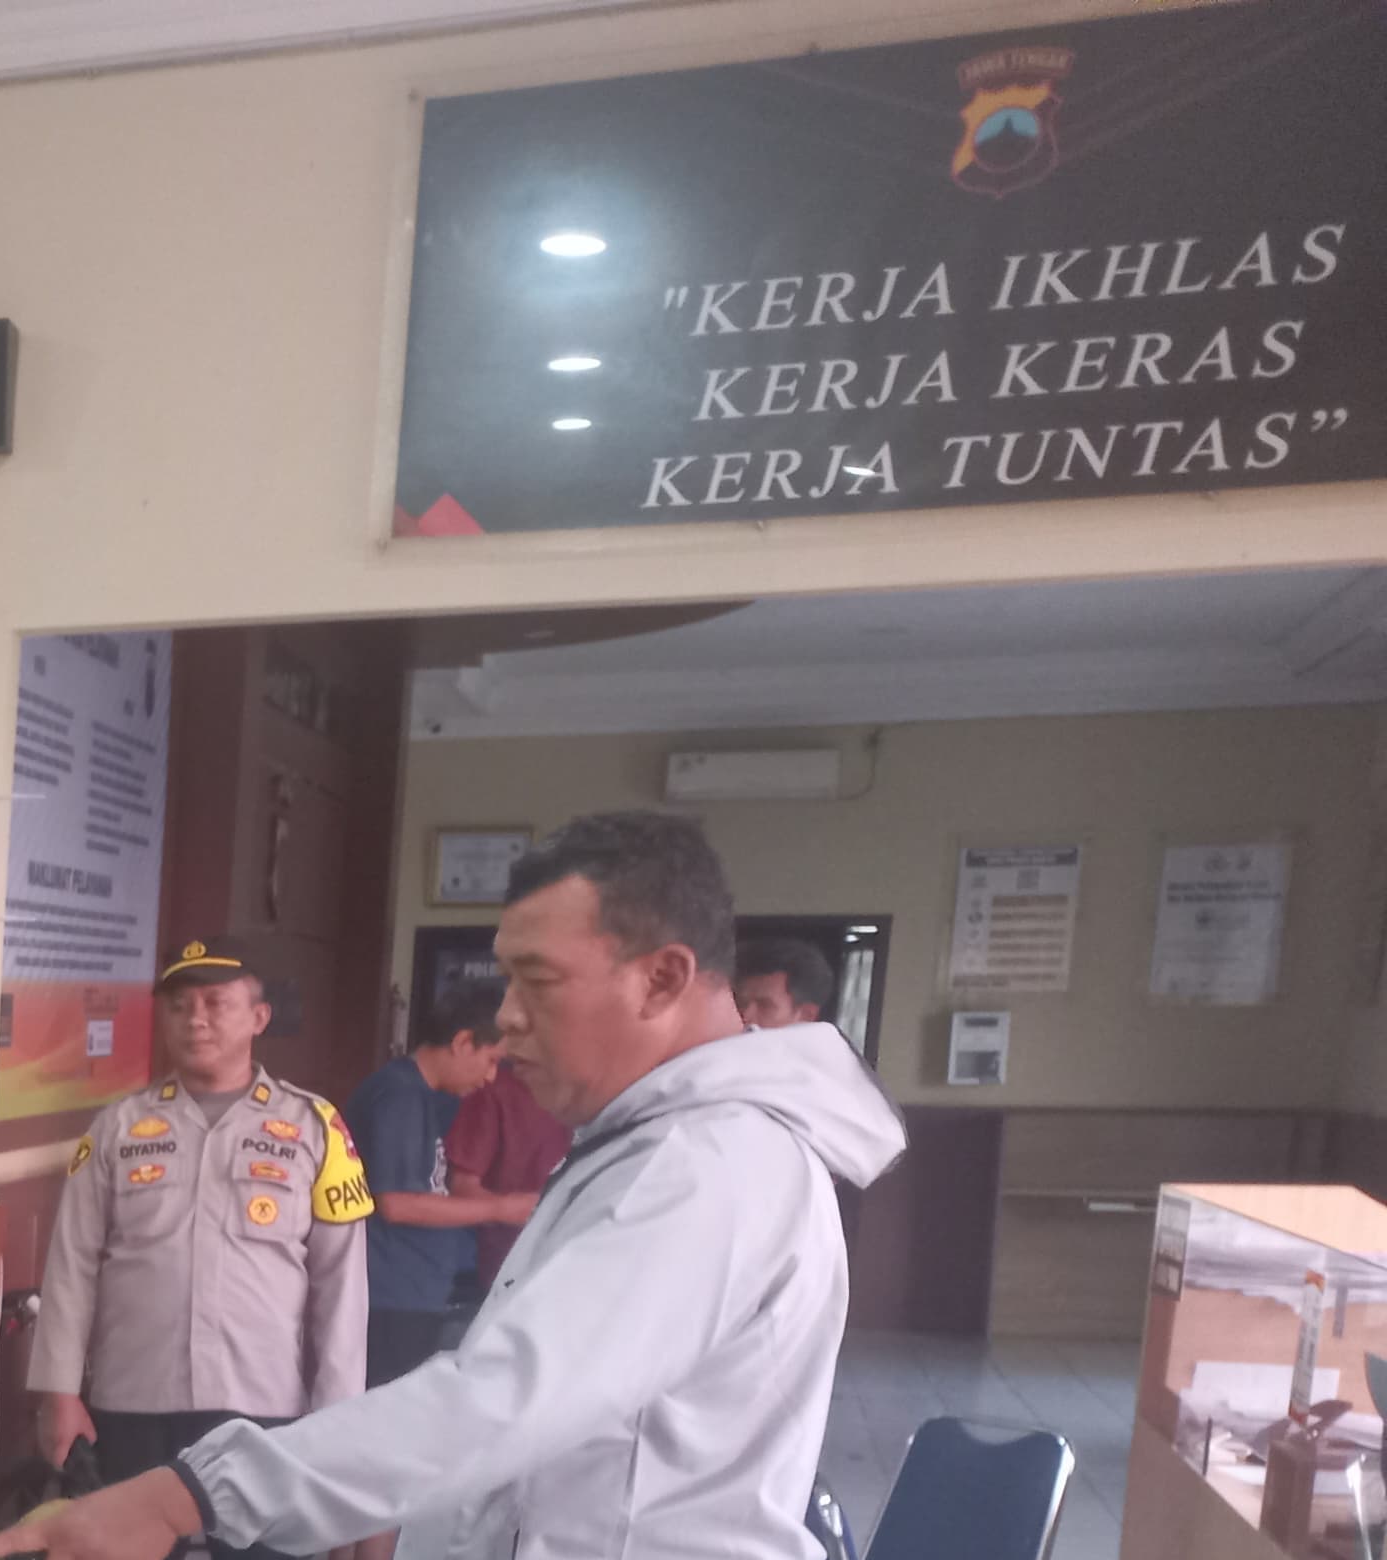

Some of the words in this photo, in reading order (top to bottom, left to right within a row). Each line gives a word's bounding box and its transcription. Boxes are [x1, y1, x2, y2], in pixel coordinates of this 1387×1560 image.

[661, 262, 954, 338] "KERJA
[992, 223, 1346, 312] IKHLAS
[691, 349, 958, 423] KERJA
[995, 320, 1307, 401] KERAS
[640, 441, 901, 511] KERJA
[242, 1138, 297, 1160] POLRI
